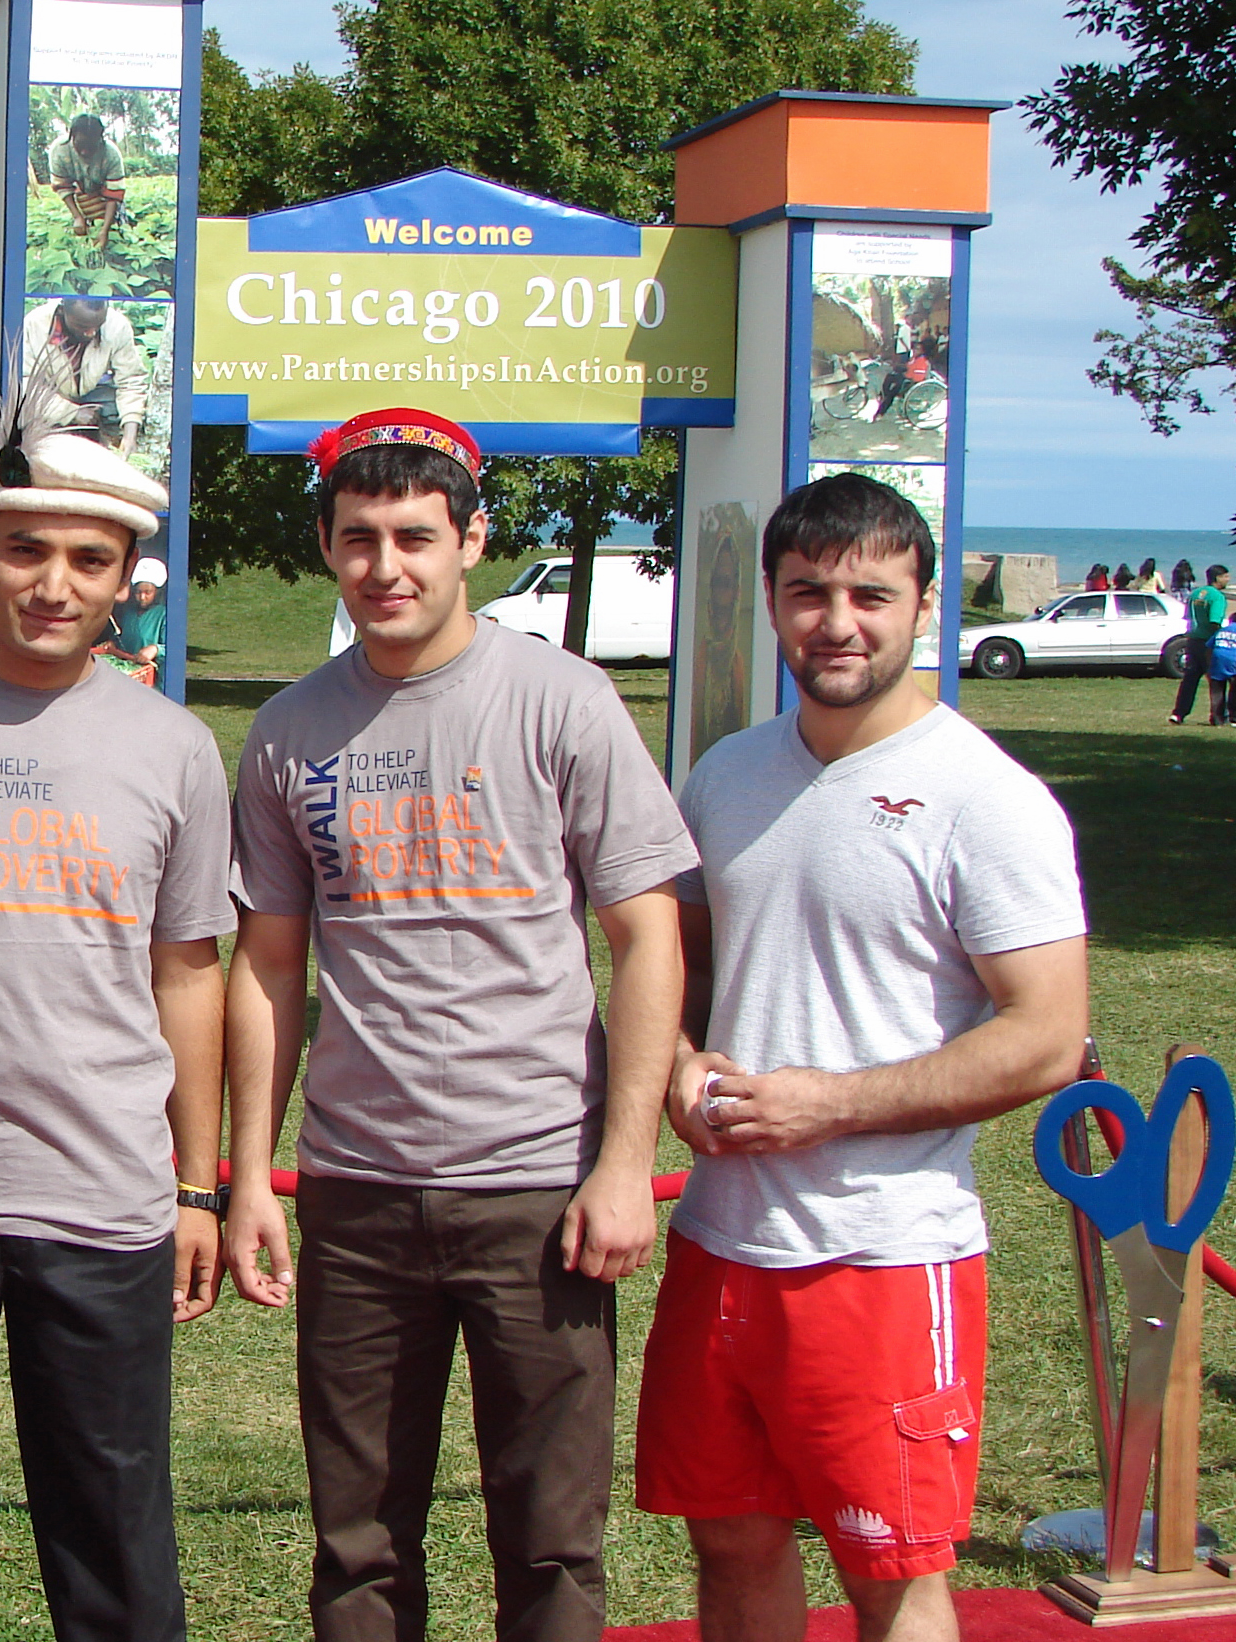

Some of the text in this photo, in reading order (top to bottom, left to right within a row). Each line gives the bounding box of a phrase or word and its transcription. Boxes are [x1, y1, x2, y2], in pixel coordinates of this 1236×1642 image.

[364, 217, 533, 247] Welcome
[226, 272, 666, 344] Chicago 2010
[348, 749, 415, 770] TO HELP
[345, 770, 428, 793] ALLEVIATE
[305, 755, 350, 901] I WALK
[347, 794, 482, 837] GLOBAL
[869, 812, 904, 831] 1922
[349, 838, 507, 880] POVERTY
